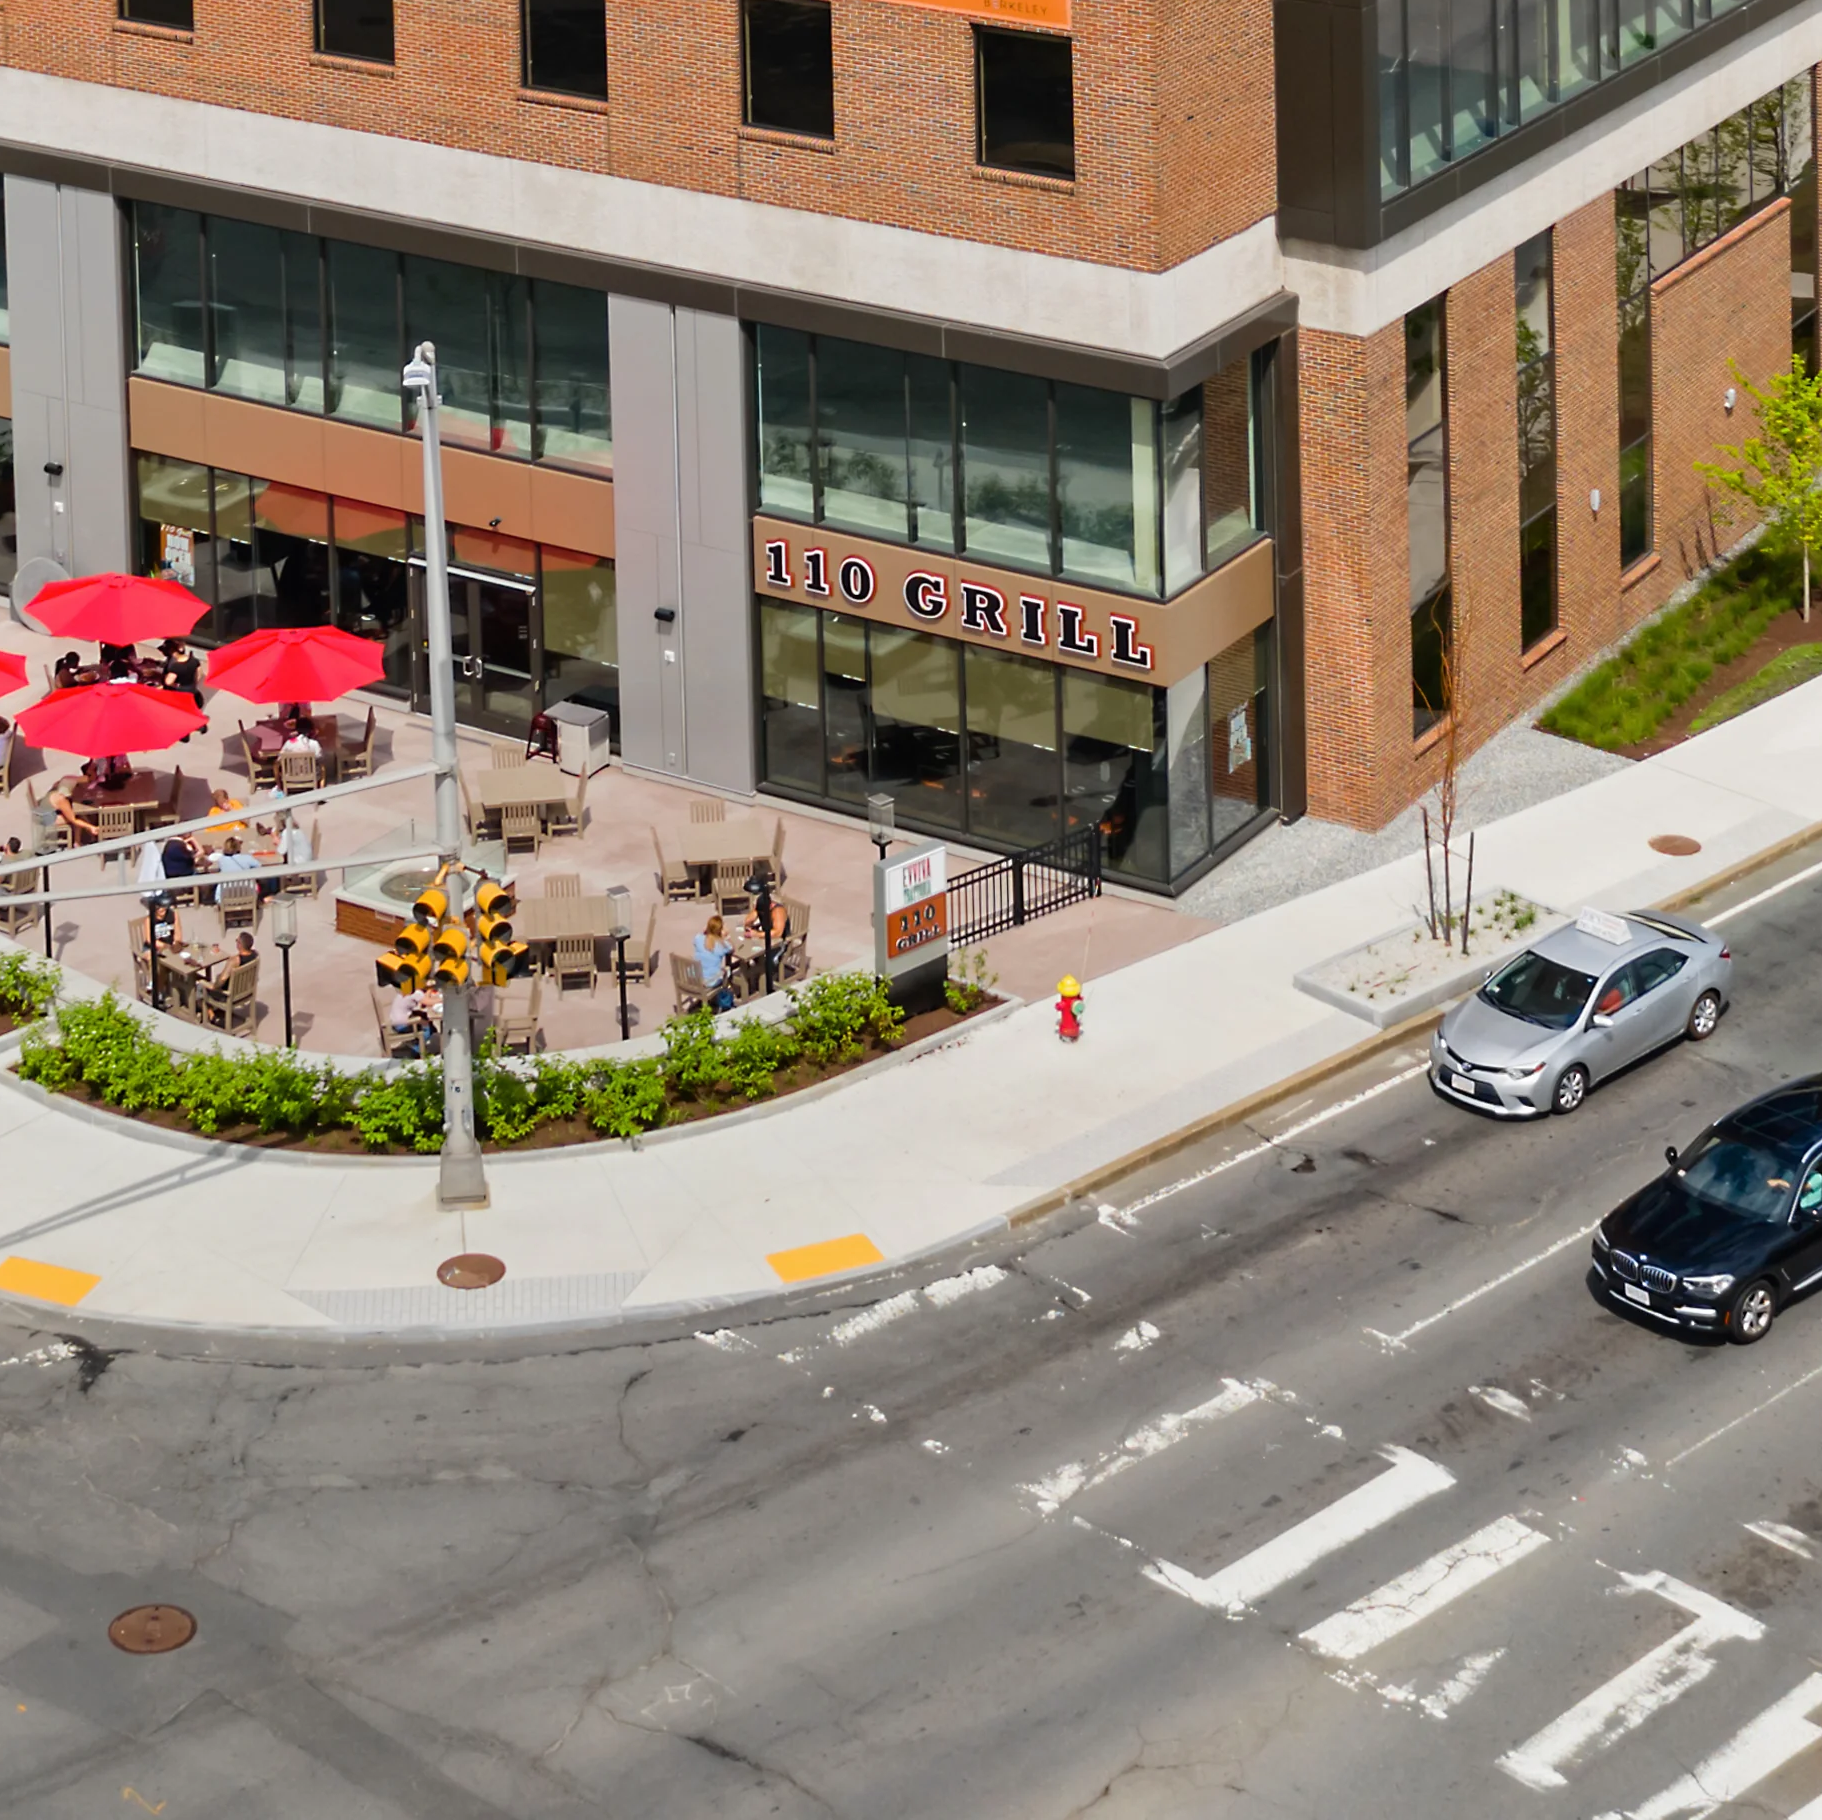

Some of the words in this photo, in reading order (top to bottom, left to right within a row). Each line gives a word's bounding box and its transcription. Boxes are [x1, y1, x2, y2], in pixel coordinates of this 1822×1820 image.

[766, 540, 876, 603] 110
[902, 569, 1155, 671] GRILL
[900, 904, 936, 932] 110
[896, 923, 941, 950] GRILL
